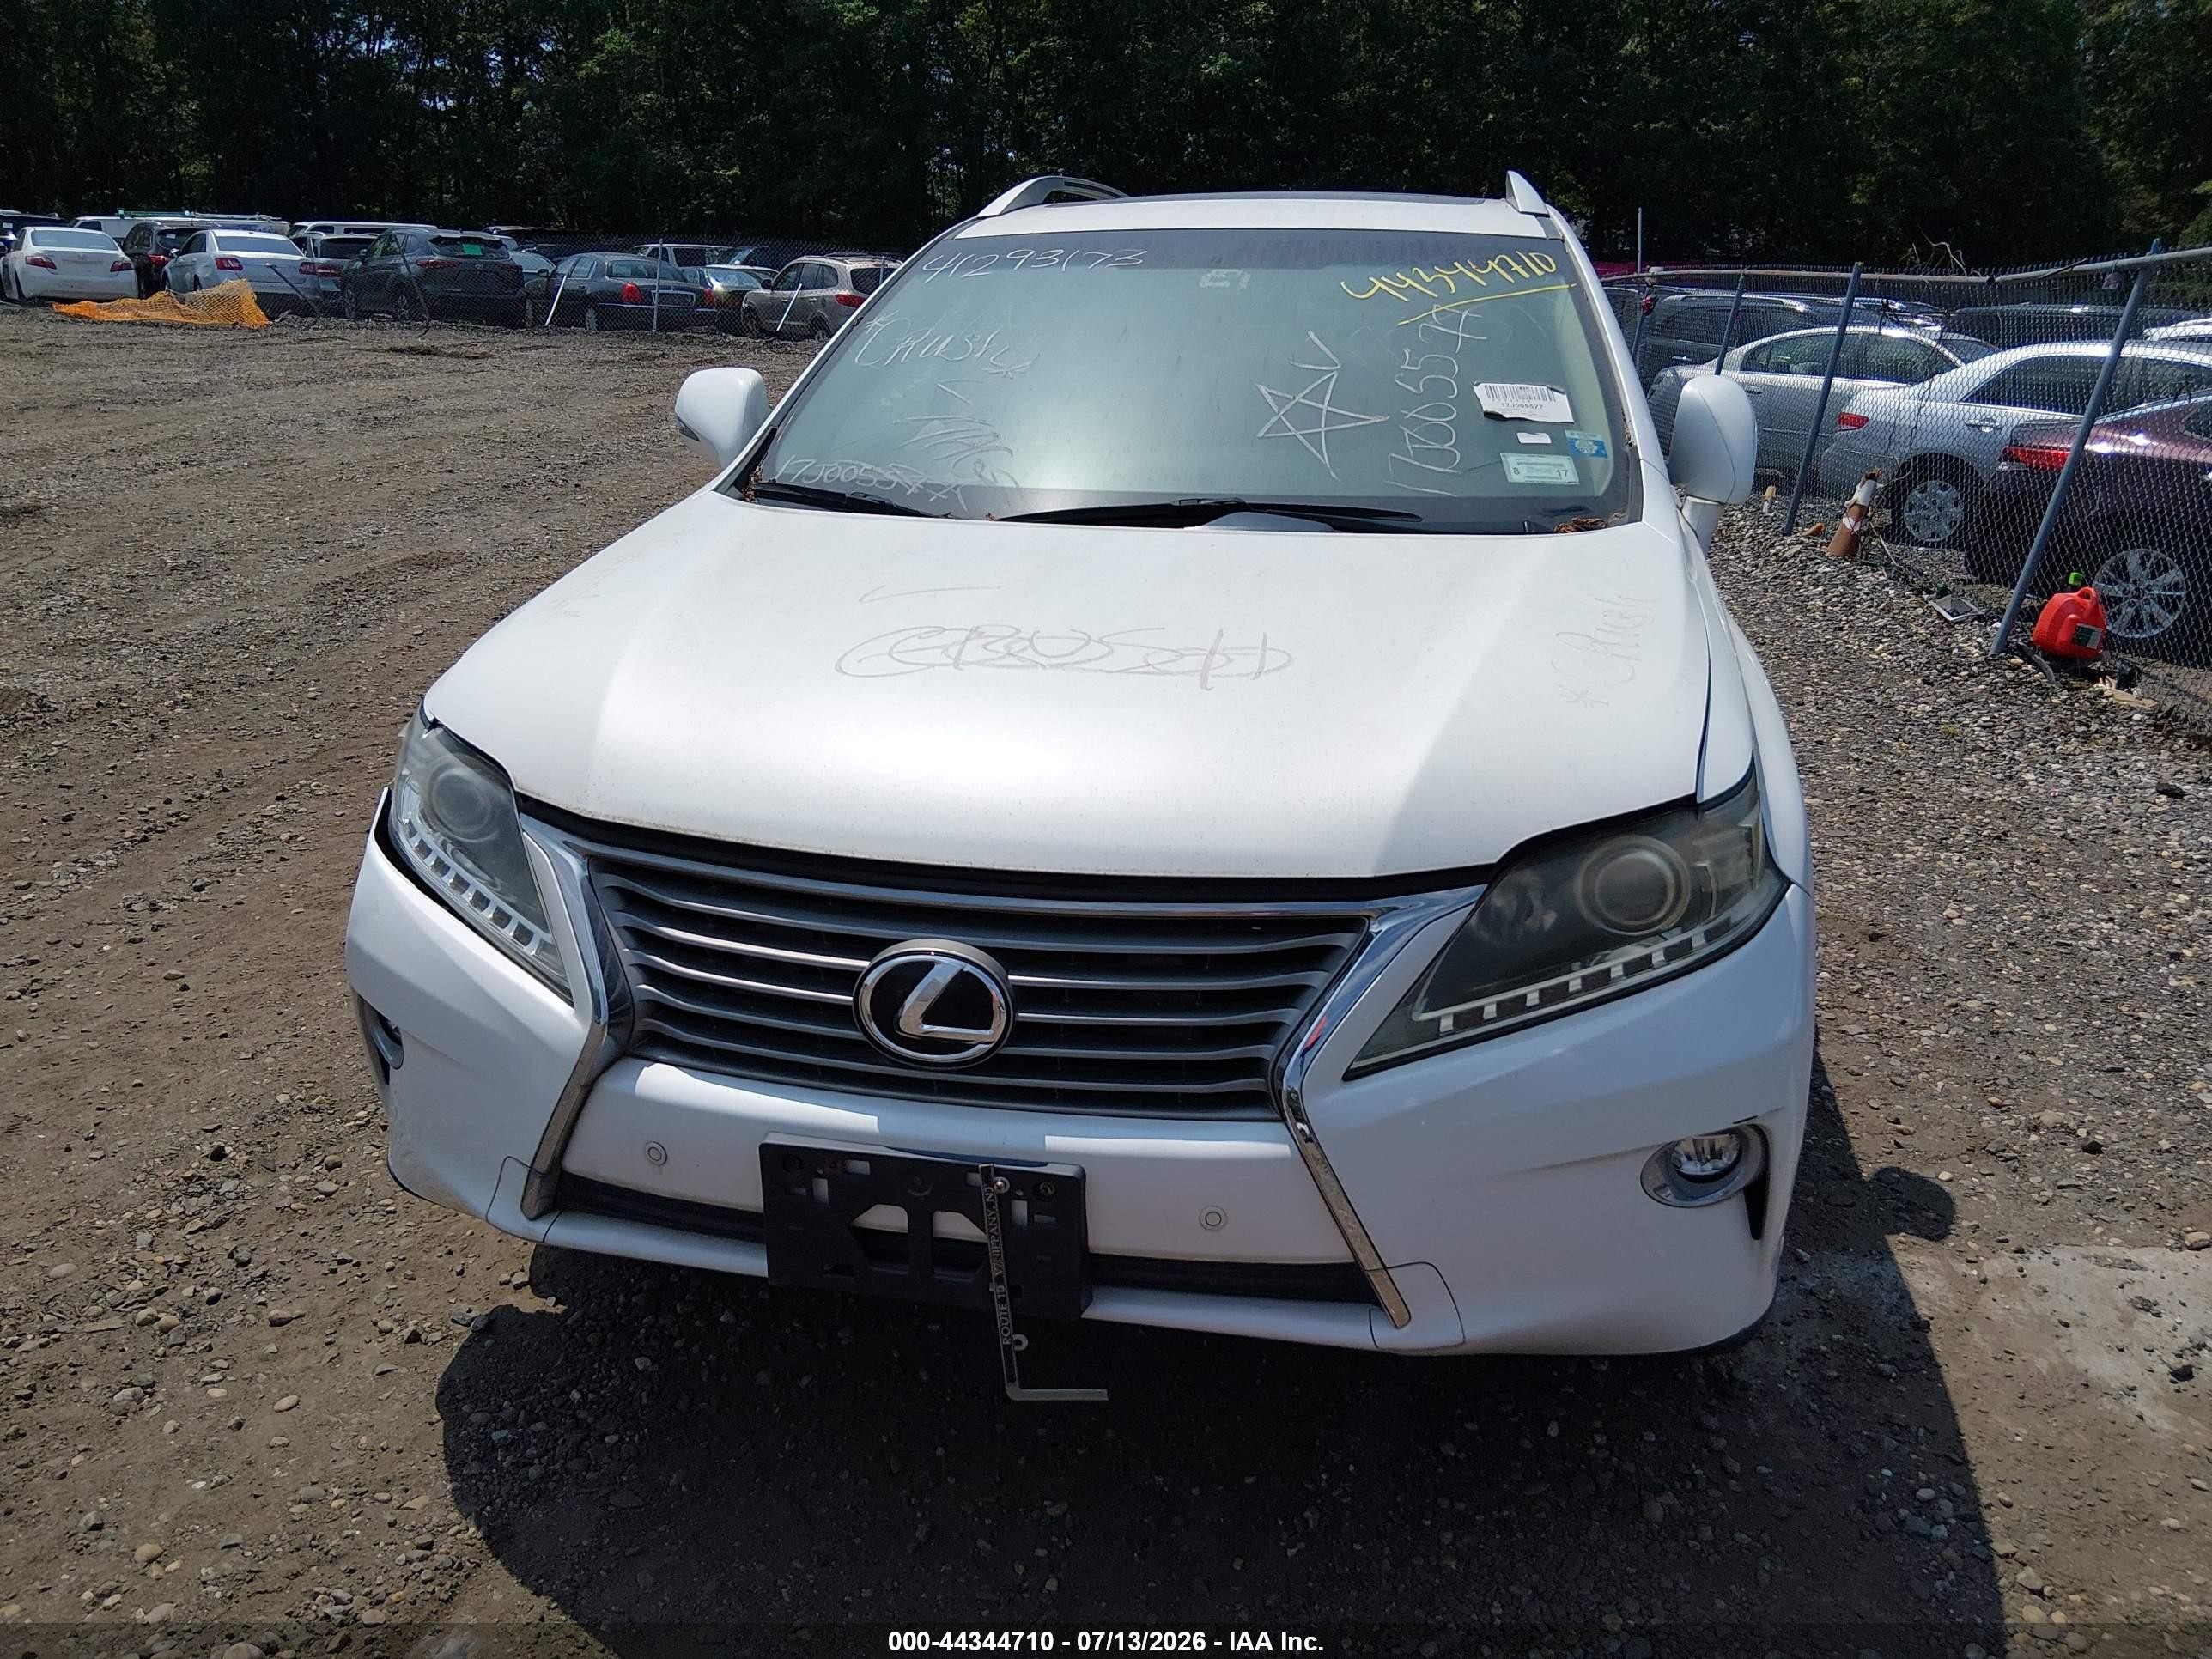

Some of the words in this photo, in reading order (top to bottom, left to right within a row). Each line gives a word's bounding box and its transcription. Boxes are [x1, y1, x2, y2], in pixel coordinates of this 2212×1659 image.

[1340, 250, 1556, 301] 44344710
[984, 1186, 995, 1203] NJ
[997, 1302, 1012, 1346] ROUTE
